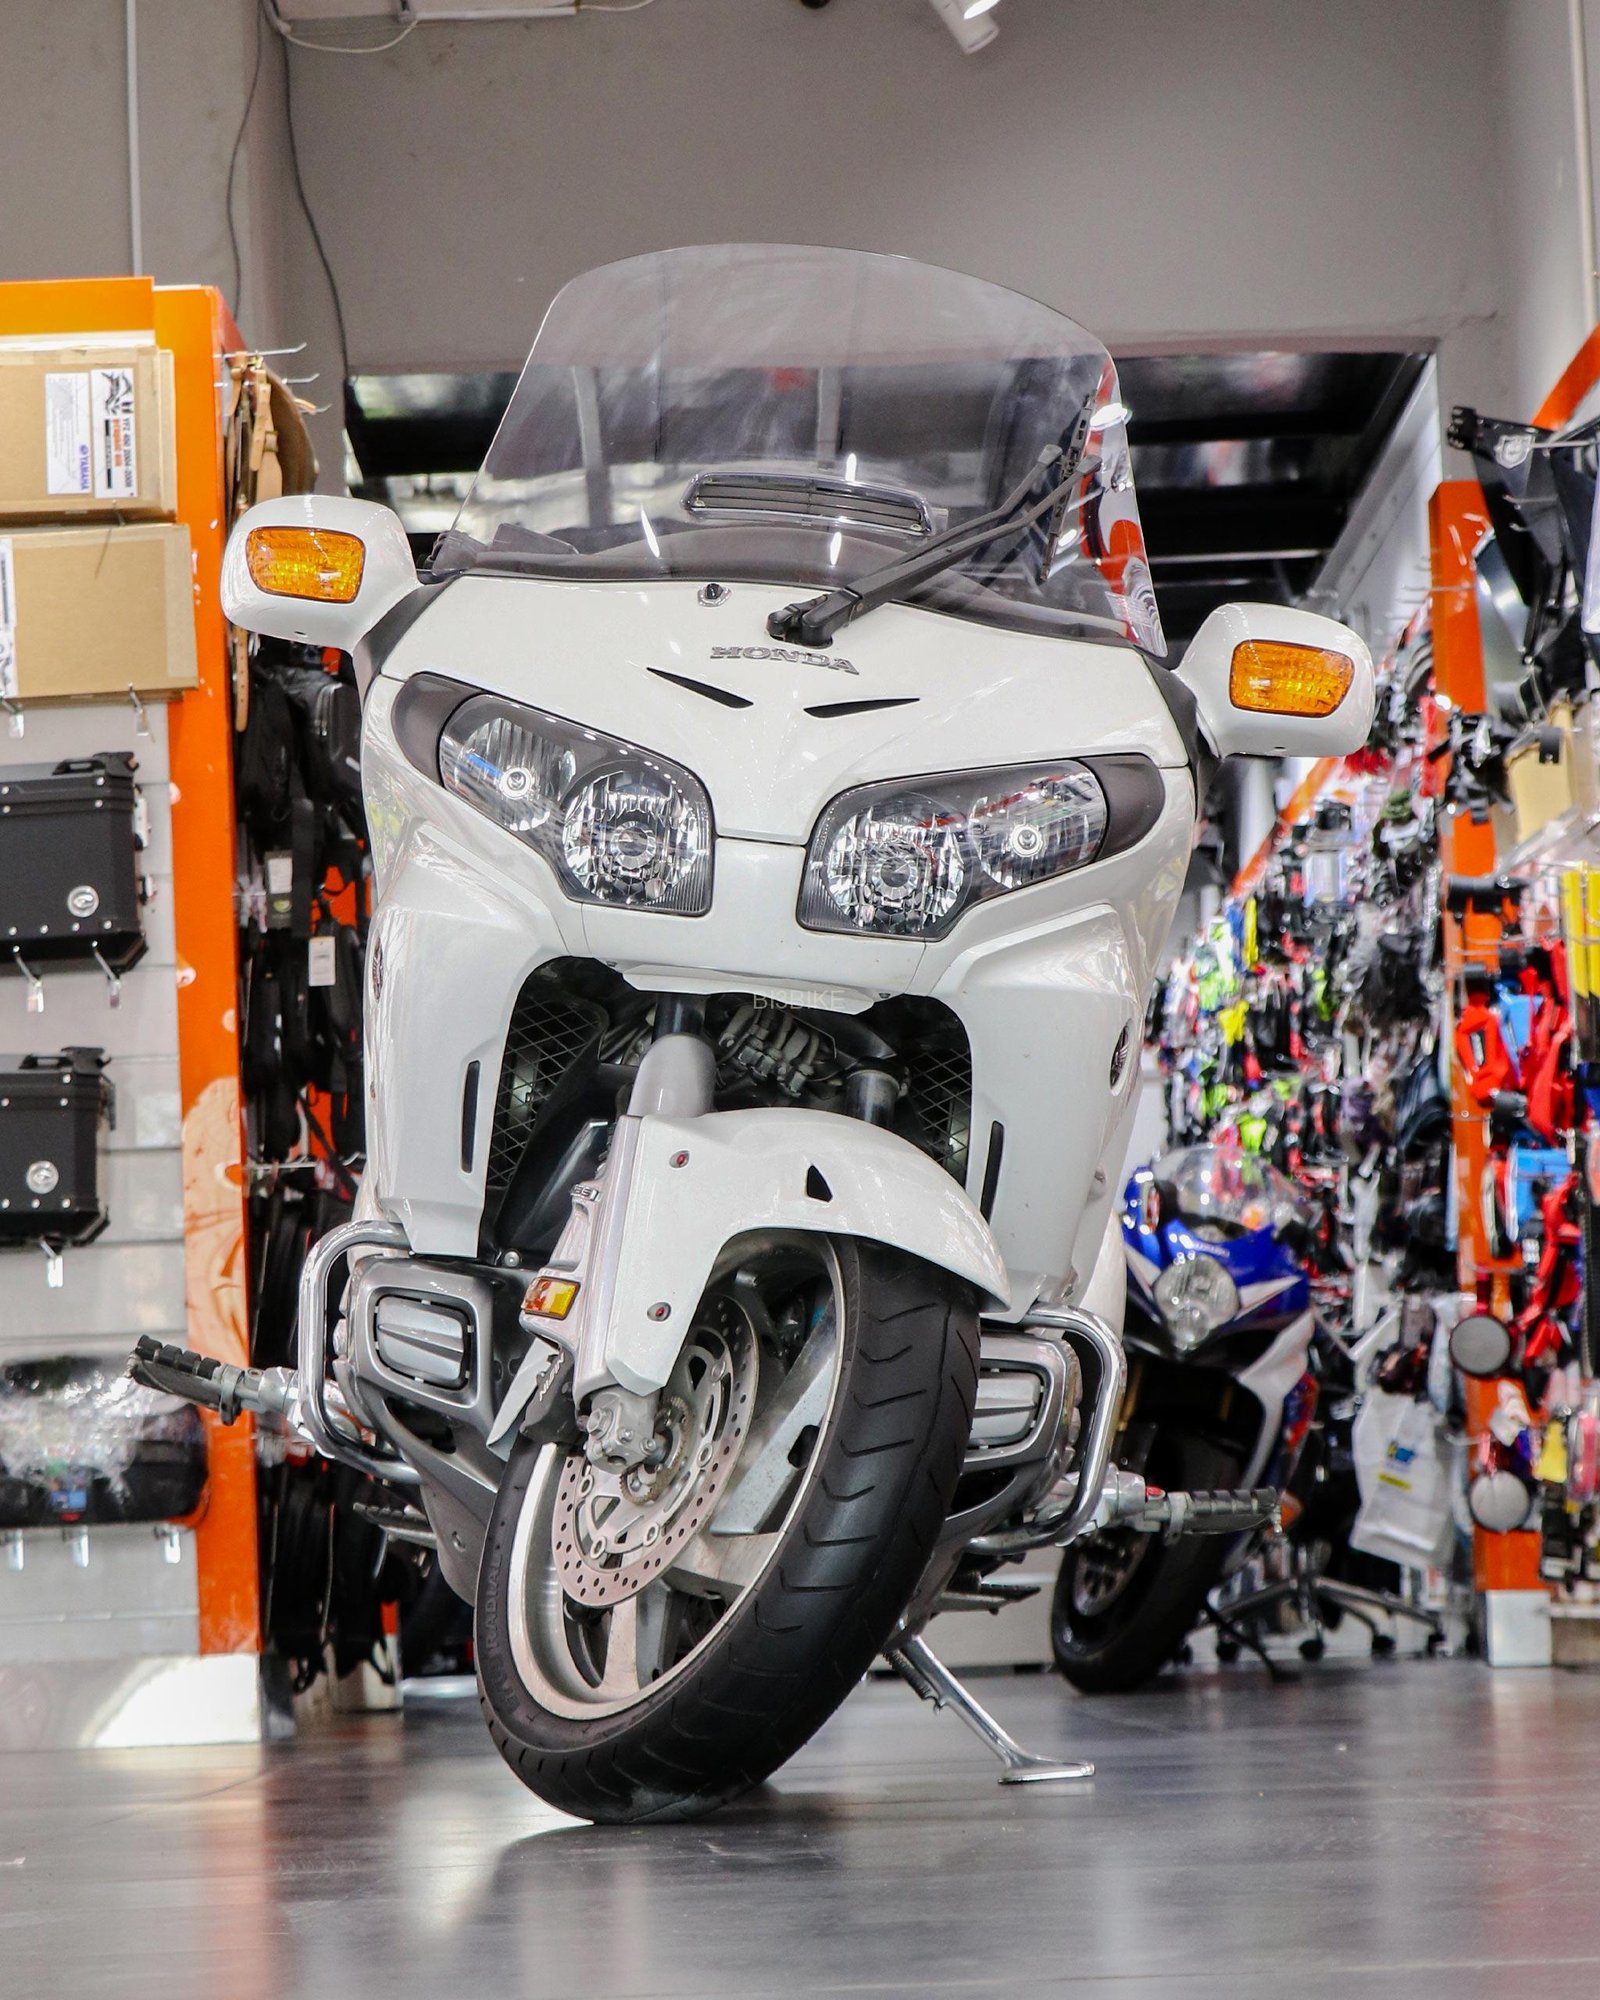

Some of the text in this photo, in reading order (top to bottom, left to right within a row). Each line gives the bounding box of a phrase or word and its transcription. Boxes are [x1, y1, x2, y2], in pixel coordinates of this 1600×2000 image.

[80, 456, 89, 491] YAMAHA
[709, 646, 860, 676] HONDA
[485, 1552, 503, 1649] RADIAL
